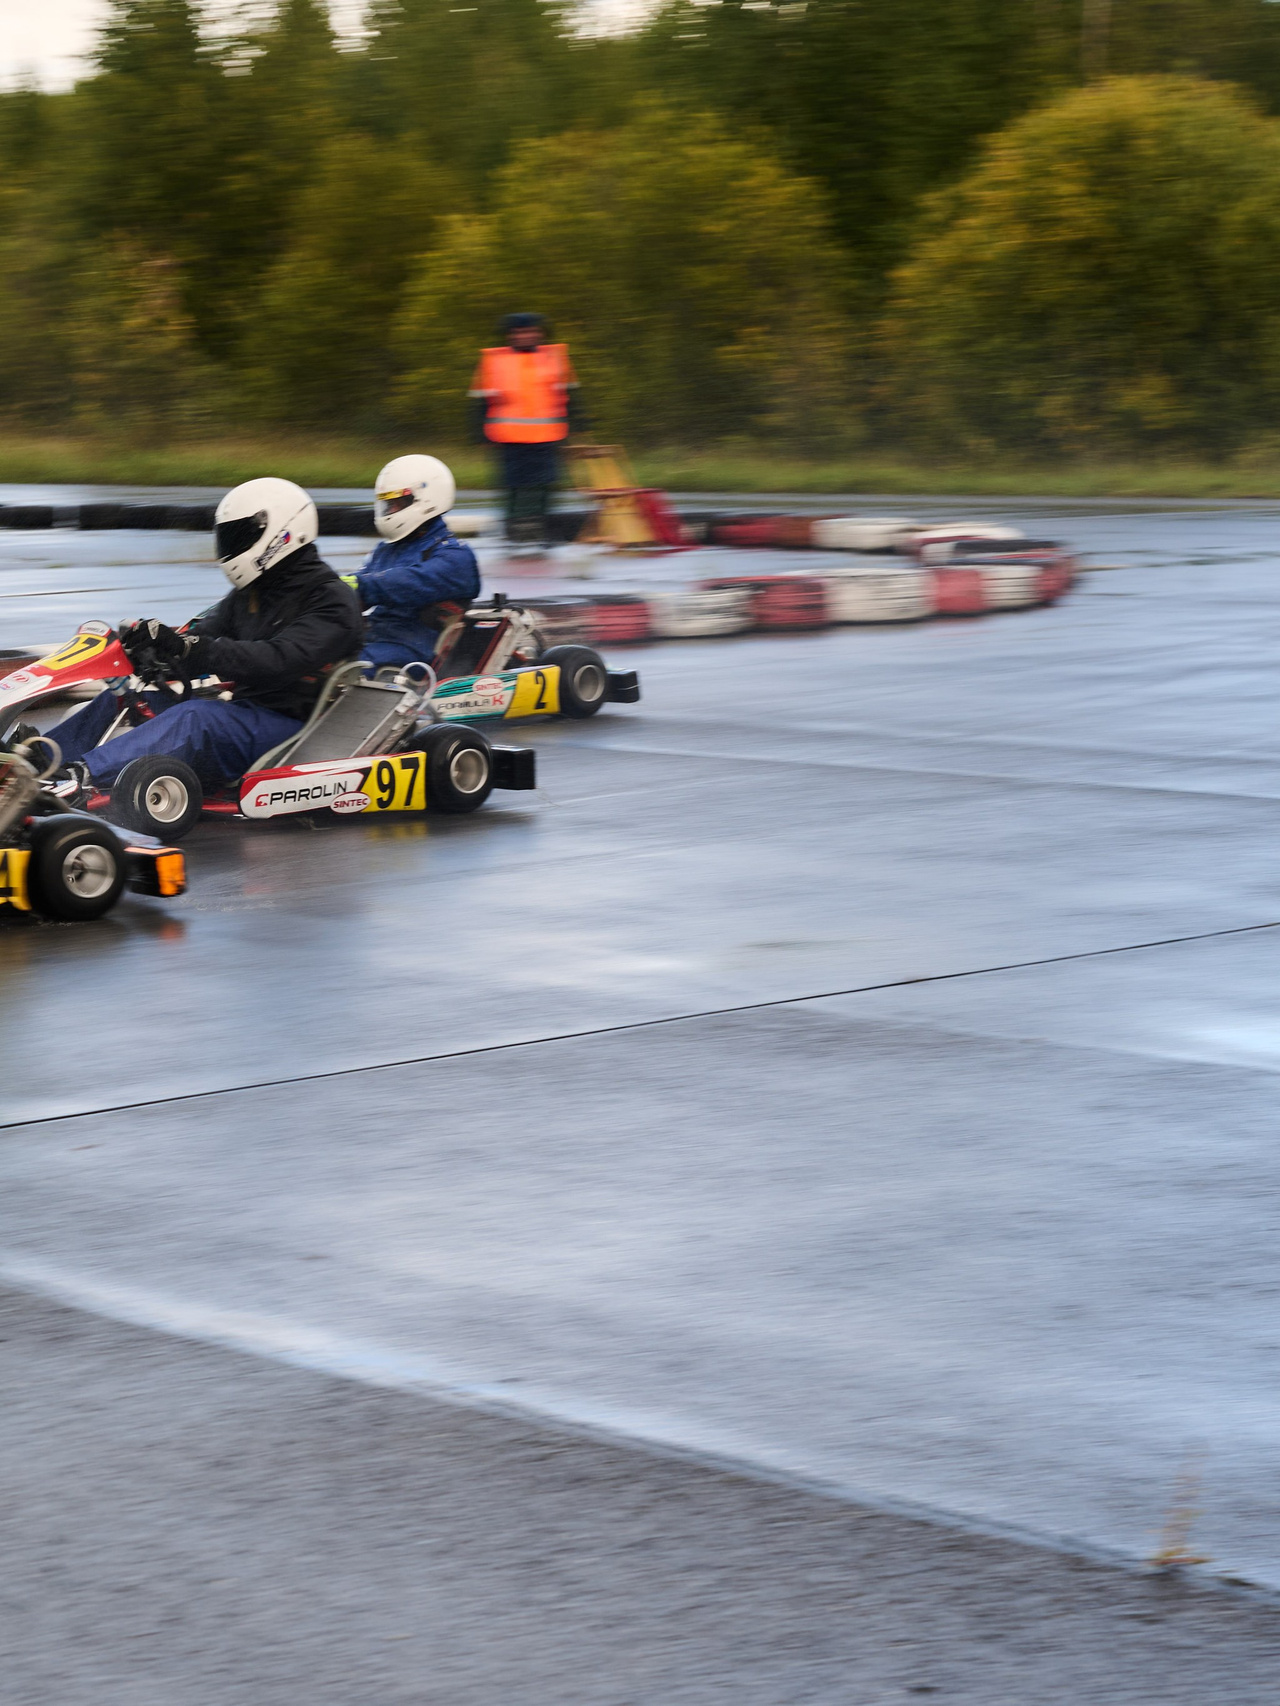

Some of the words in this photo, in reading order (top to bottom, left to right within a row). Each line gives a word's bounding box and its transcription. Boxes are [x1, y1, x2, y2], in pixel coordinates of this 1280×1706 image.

[492, 695, 504, 706] K
[534, 670, 547, 710] 2
[376, 757, 420, 809] 97
[333, 797, 369, 809] SINTEC
